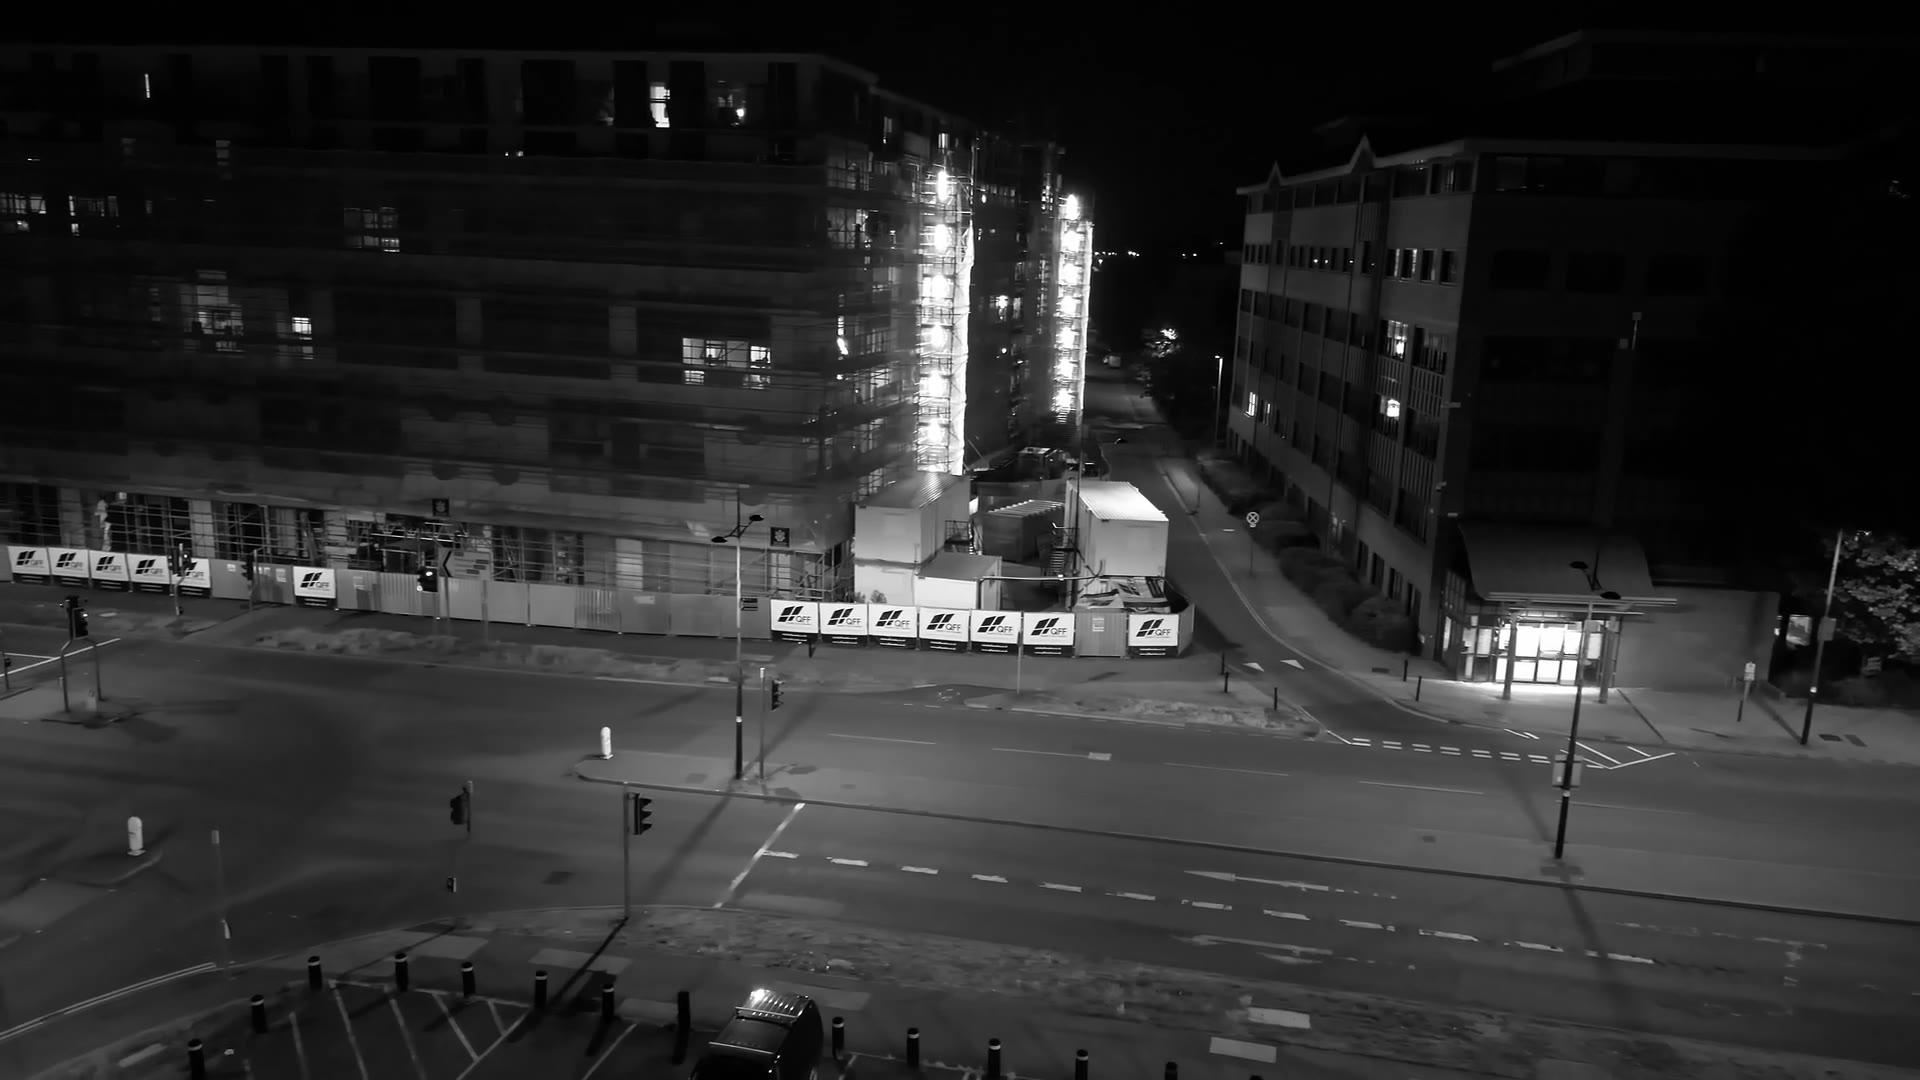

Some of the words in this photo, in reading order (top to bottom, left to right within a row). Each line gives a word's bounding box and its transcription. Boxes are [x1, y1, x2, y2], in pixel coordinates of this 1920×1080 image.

[894, 619, 911, 627] QFF
[945, 623, 961, 631] QFF
[996, 625, 1013, 633] QFF
[1050, 627, 1068, 635] QFF
[1155, 628, 1172, 636] QFF
